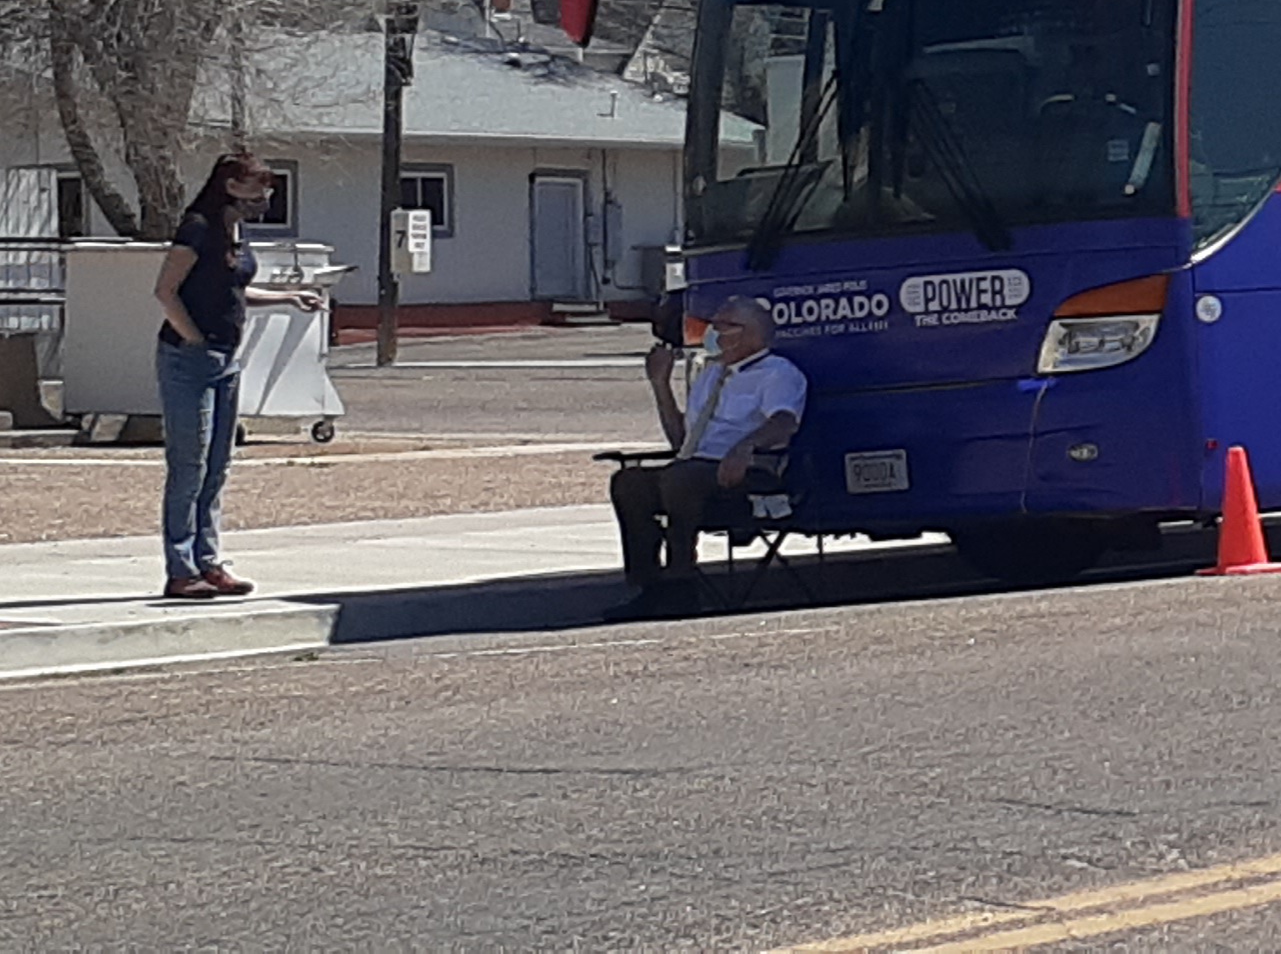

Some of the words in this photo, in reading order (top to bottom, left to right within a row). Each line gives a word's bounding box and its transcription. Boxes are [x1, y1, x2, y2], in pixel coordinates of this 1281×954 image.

[395, 229, 407, 249] 7
[757, 293, 889, 325] OLORADO
[923, 274, 1006, 312] POWER
